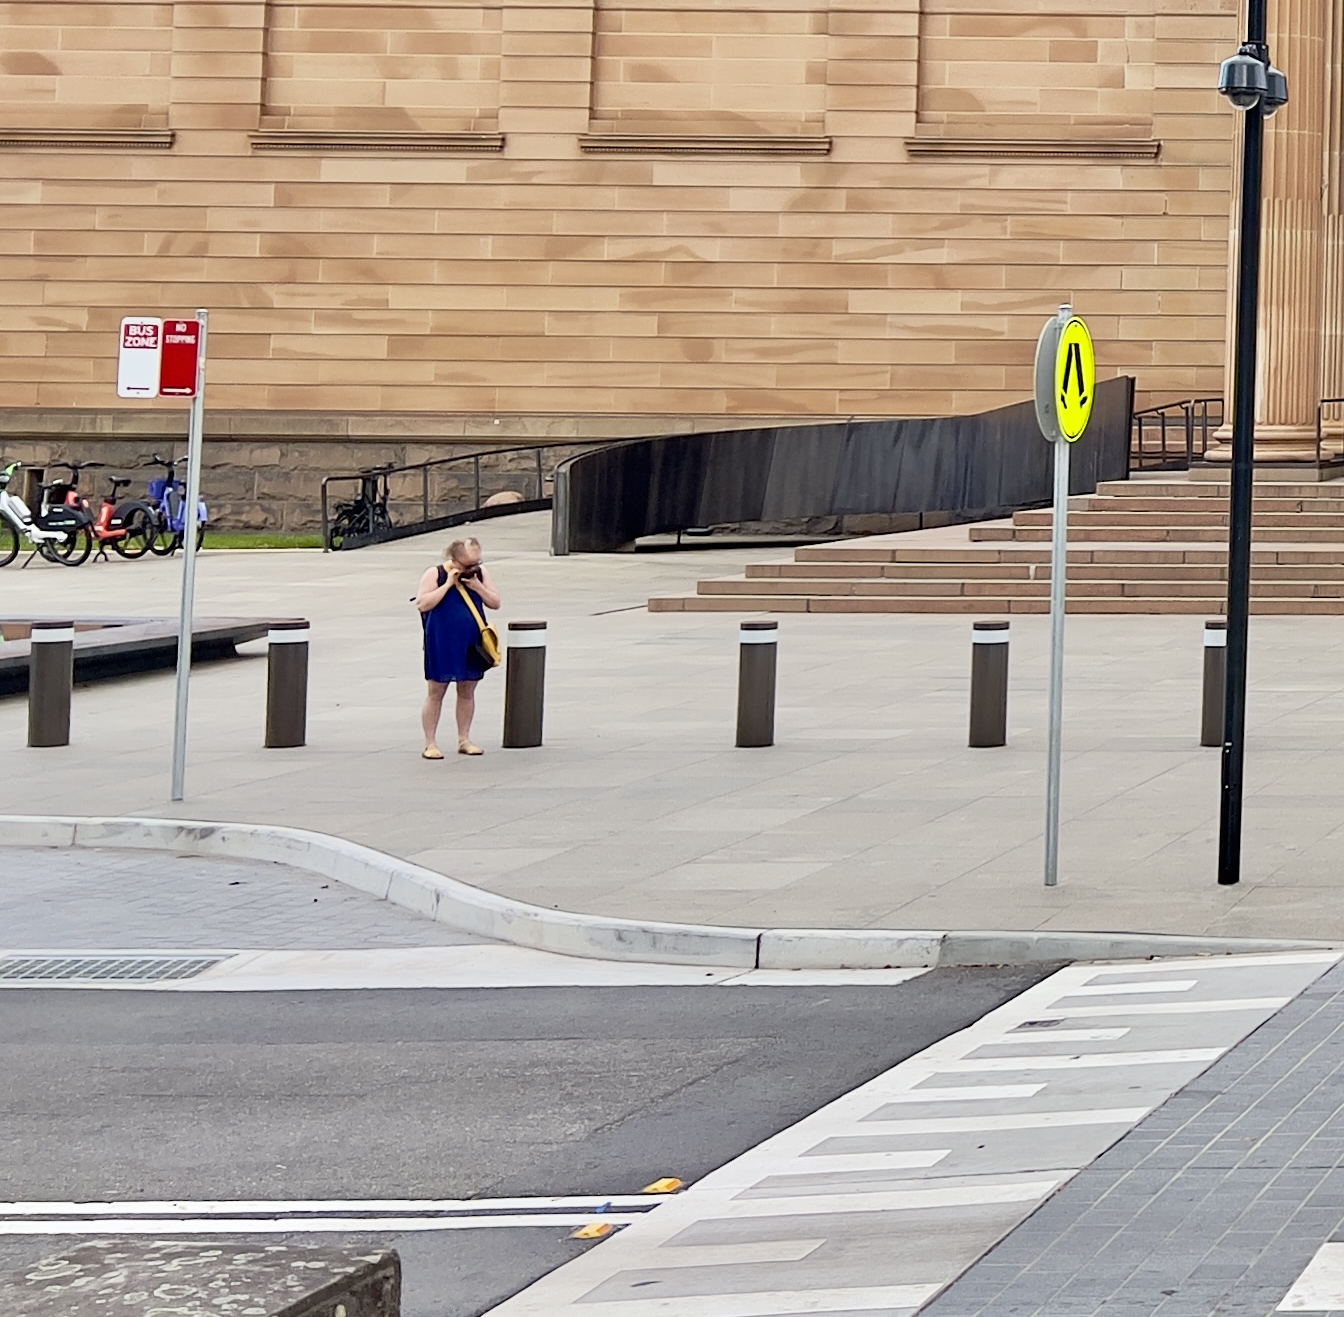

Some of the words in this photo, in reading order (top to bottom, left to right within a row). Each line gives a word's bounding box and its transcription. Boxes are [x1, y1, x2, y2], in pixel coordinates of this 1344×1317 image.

[128, 325, 154, 337] BUS
[175, 323, 187, 332] NO
[124, 336, 157, 348] ZONE
